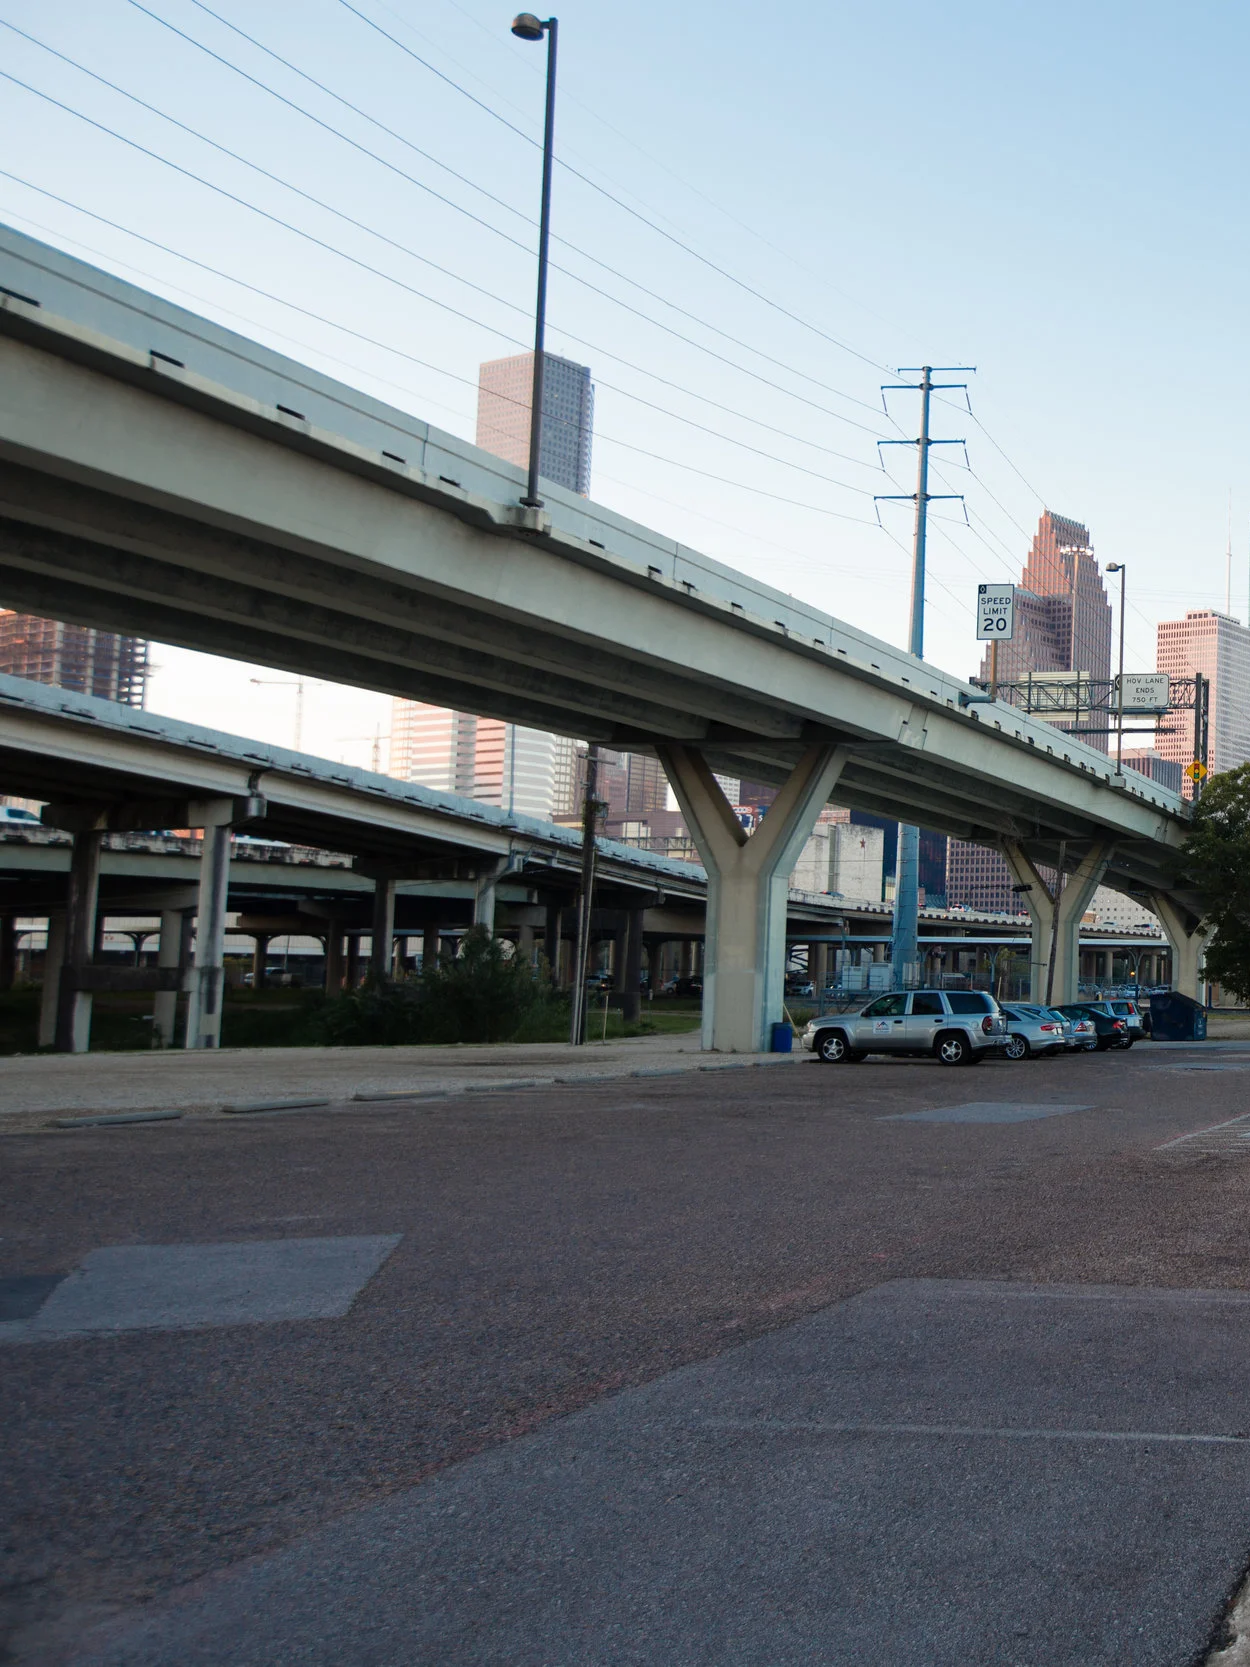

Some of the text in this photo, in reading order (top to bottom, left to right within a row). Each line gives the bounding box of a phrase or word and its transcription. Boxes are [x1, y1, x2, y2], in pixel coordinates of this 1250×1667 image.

[981, 597, 1011, 605] SPEED
[983, 607, 1008, 615] LIMIT
[983, 617, 1007, 631] 20
